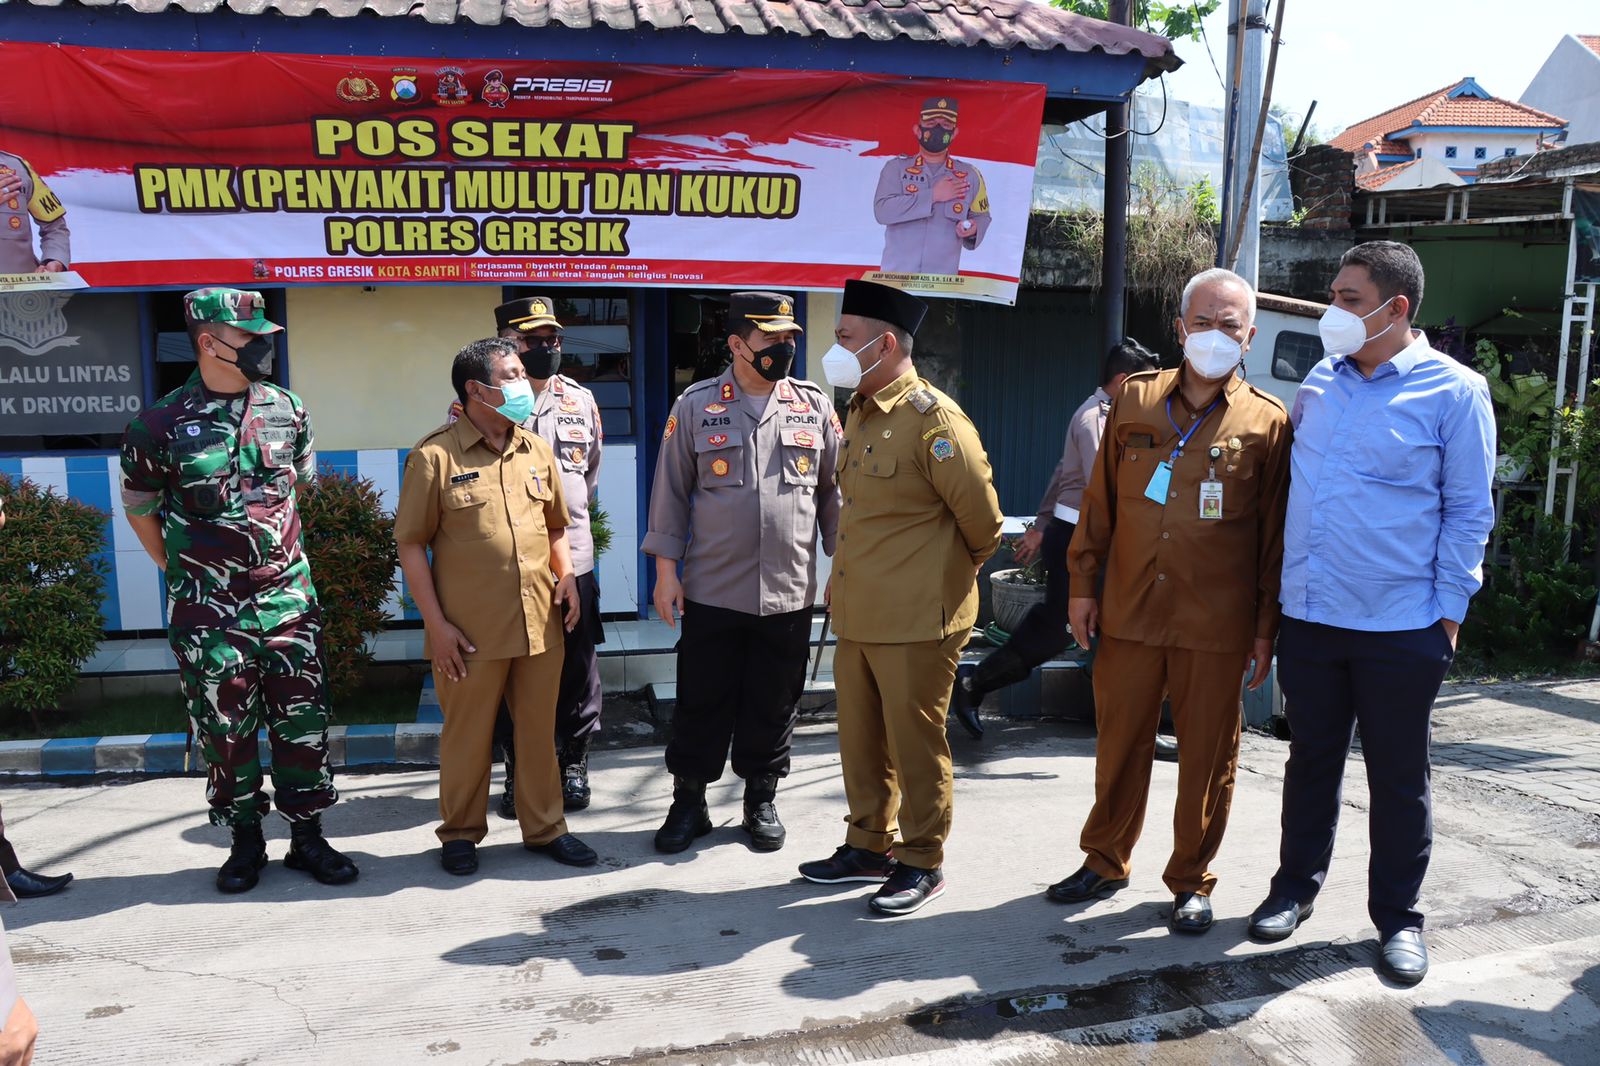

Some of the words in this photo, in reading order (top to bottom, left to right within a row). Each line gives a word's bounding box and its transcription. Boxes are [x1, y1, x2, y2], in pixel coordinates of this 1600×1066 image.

[513, 77, 612, 93] PRESISI
[313, 118, 437, 158] POS
[450, 119, 635, 160] SEKAT
[138, 167, 237, 210] PMK
[241, 168, 446, 211] (PENYAKIT
[454, 170, 586, 211] MULUT
[594, 172, 672, 213] DAN
[679, 174, 798, 217] KUKU)
[328, 219, 477, 252] POLRES
[484, 220, 628, 253] GRESIK
[274, 265, 324, 278] POLRES
[327, 265, 374, 278] GRESIK
[377, 265, 411, 277] KOTA
[414, 265, 460, 277] SANTRI
[470, 262, 523, 271] Kerjasama
[525, 262, 566, 271] Obyektif
[569, 262, 607, 271] Teladan
[610, 263, 649, 271] Amanah
[470, 270, 527, 278] Silaturahmi
[530, 270, 549, 278] Adil
[552, 270, 582, 278] Netral
[585, 271, 625, 279] Tangguh
[627, 271, 667, 280] Religius
[669, 272, 704, 280] Inovasi
[57, 365, 131, 383] LINTAS
[23, 395, 141, 415] DRIYOREJO
[557, 416, 585, 427] POLRI
[701, 416, 731, 428] AZIS
[785, 415, 818, 425] POLRI
